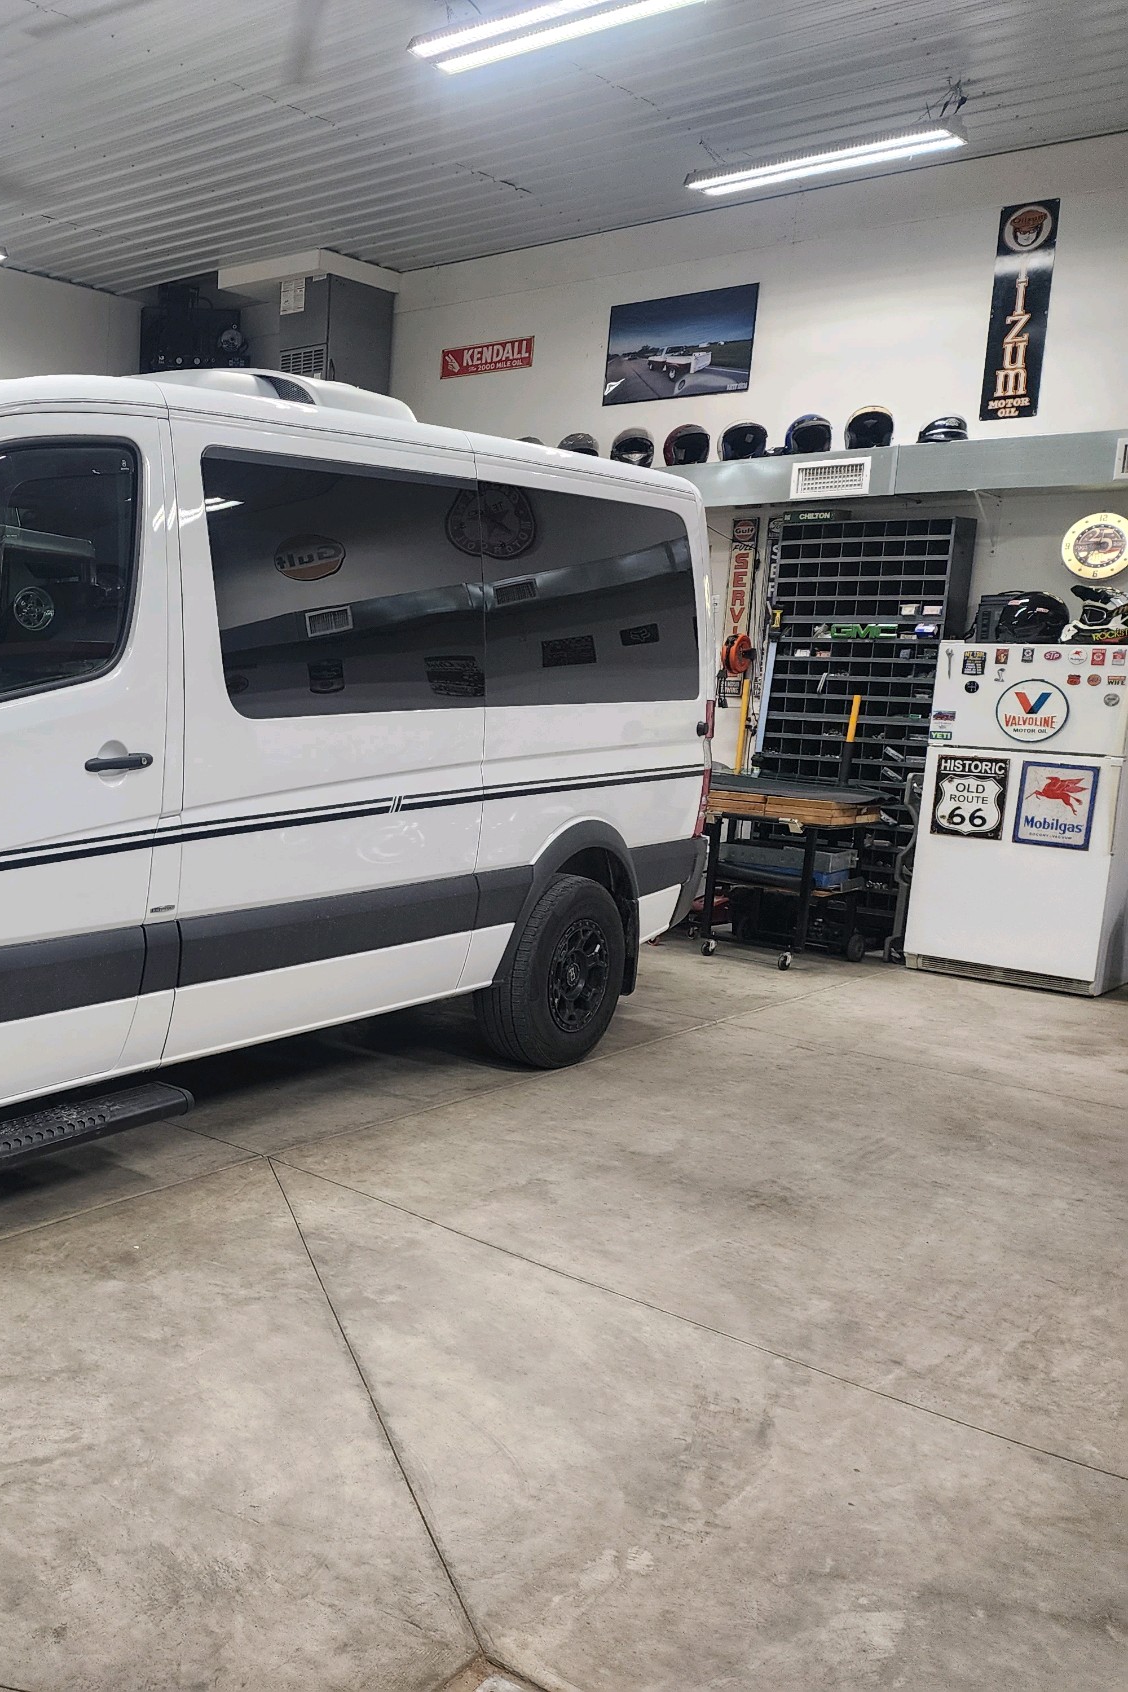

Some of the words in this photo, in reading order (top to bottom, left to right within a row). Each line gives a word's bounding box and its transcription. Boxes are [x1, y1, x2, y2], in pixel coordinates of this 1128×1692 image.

[463, 341, 529, 366] KENDALL
[496, 361, 511, 369] MILE
[988, 397, 1030, 410] MOTOR
[997, 408, 1019, 418] OIL
[799, 511, 831, 520] CHILTON
[831, 623, 898, 639] GMC
[1045, 651, 1060, 659] STP
[1004, 713, 1056, 729] VALVOLINE
[931, 731, 951, 739] YETI
[940, 759, 1006, 775] HISTORIC
[955, 782, 986, 794] OLD
[949, 793, 989, 805] ROUTE
[947, 806, 987, 828] 66
[1024, 815, 1083, 834] Mobilgas
